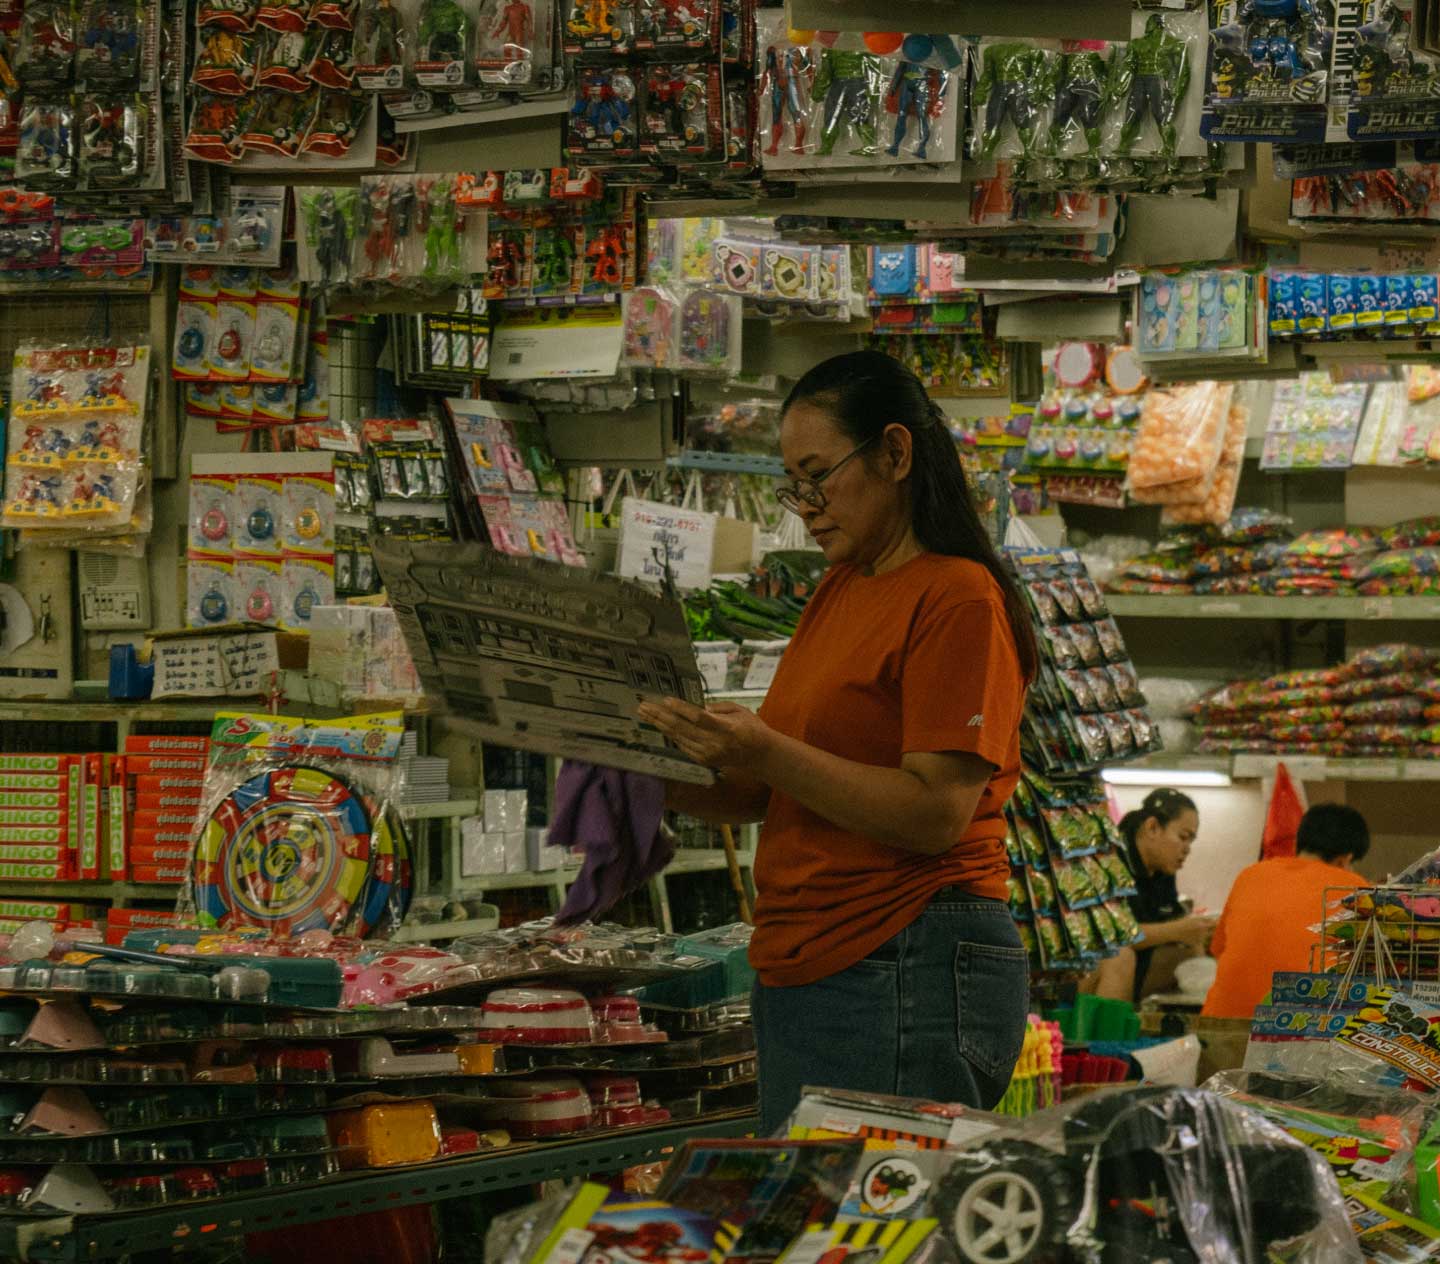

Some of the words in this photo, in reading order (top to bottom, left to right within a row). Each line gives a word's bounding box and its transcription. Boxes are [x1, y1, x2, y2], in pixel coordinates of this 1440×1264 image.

[1222, 114, 1294, 129] POLICE
[1367, 111, 1437, 127] POLICE
[83, 785, 97, 868] BINGO
